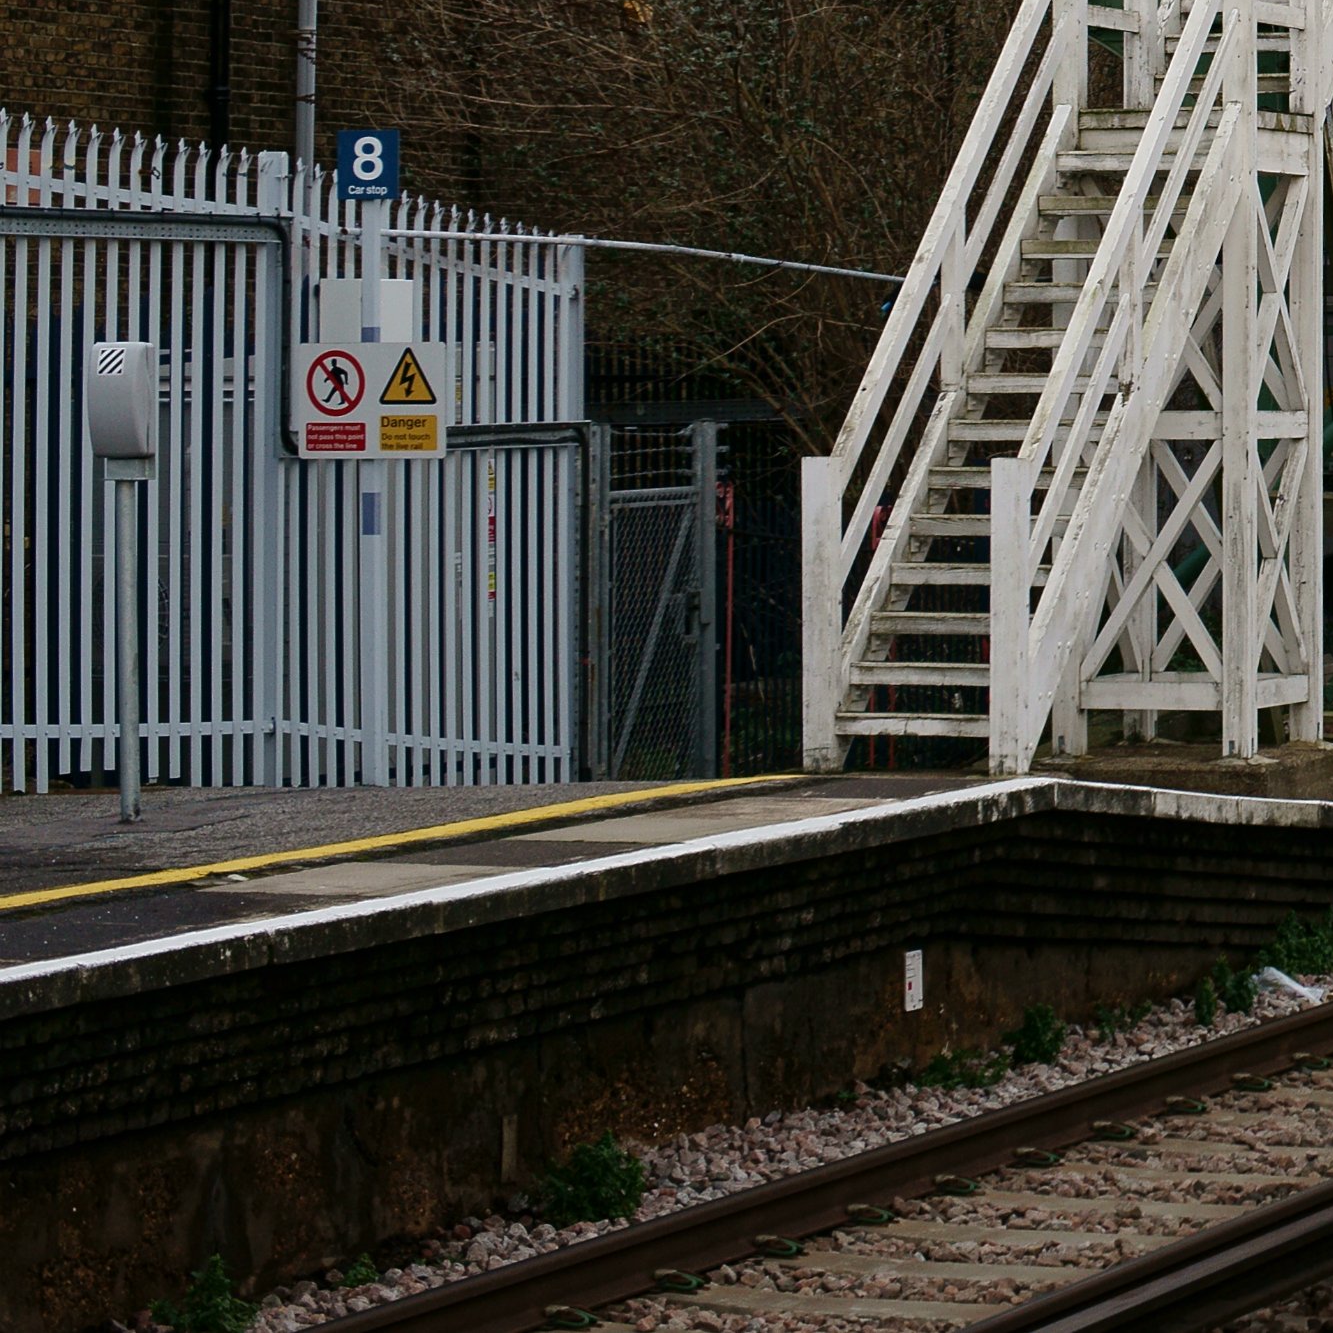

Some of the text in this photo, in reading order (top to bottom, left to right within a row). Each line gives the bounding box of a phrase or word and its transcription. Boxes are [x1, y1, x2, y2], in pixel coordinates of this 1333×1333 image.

[352, 135, 384, 181] 8
[347, 185, 388, 197] Car stop
[307, 424, 343, 432] Passengers
[380, 416, 427, 430] Danger
[347, 433, 364, 441] point
[381, 433, 430, 441] Do not touch
